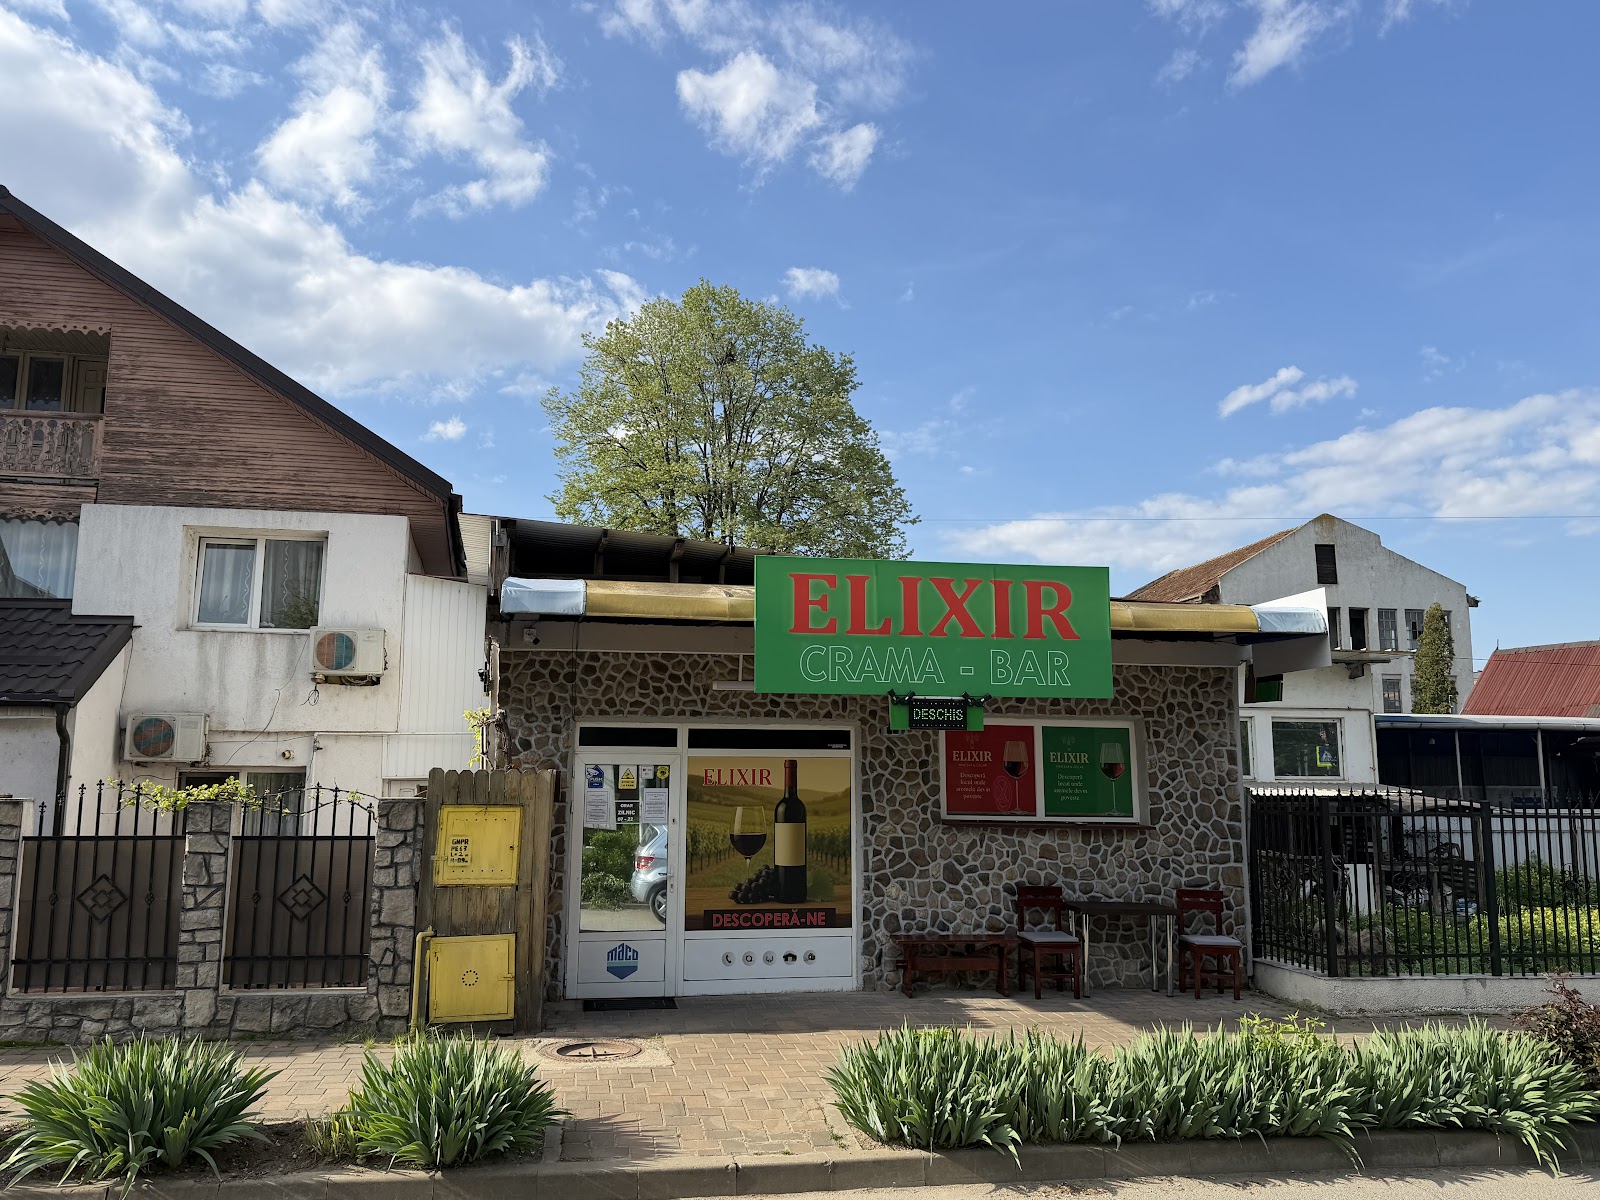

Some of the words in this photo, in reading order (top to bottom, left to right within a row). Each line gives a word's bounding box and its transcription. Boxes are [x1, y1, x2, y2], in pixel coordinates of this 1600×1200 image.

[788, 573, 1081, 640] ELIXIR
[799, 644, 945, 685] CRAMA
[959, 666, 974, 676] -
[990, 649, 1072, 687] BAR
[913, 708, 963, 721] DESCHIS
[952, 750, 993, 762] ELIXIR
[1049, 752, 1090, 764] ELIXIR
[703, 768, 772, 786] ELIXIR
[712, 908, 826, 927] DESCOPERĂ-NE
[607, 942, 639, 961] maco
